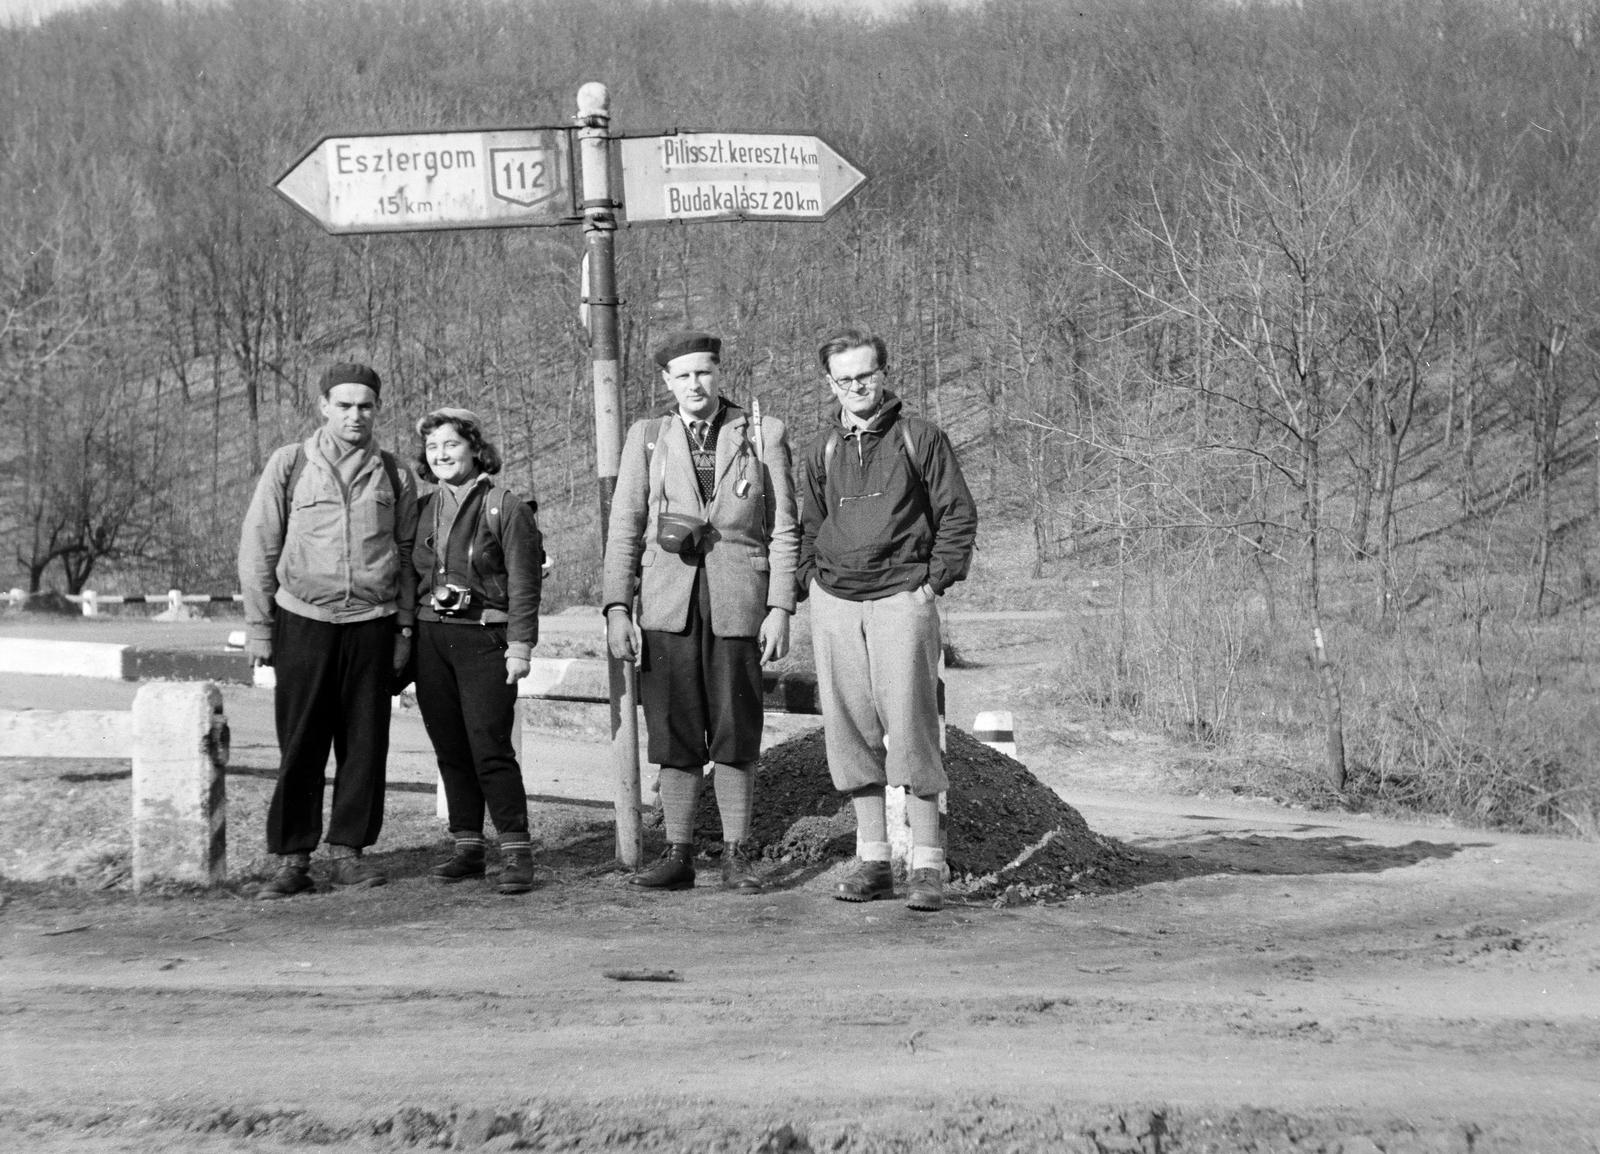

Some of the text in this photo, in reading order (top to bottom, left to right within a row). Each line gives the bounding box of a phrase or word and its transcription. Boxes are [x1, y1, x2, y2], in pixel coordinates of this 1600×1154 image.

[336, 144, 476, 178] Esztergom
[790, 146, 799, 165] 4
[801, 146, 818, 165] km
[502, 161, 546, 190] 112
[378, 196, 433, 215] 15 km
[669, 185, 819, 214] Budakalász 20 km
